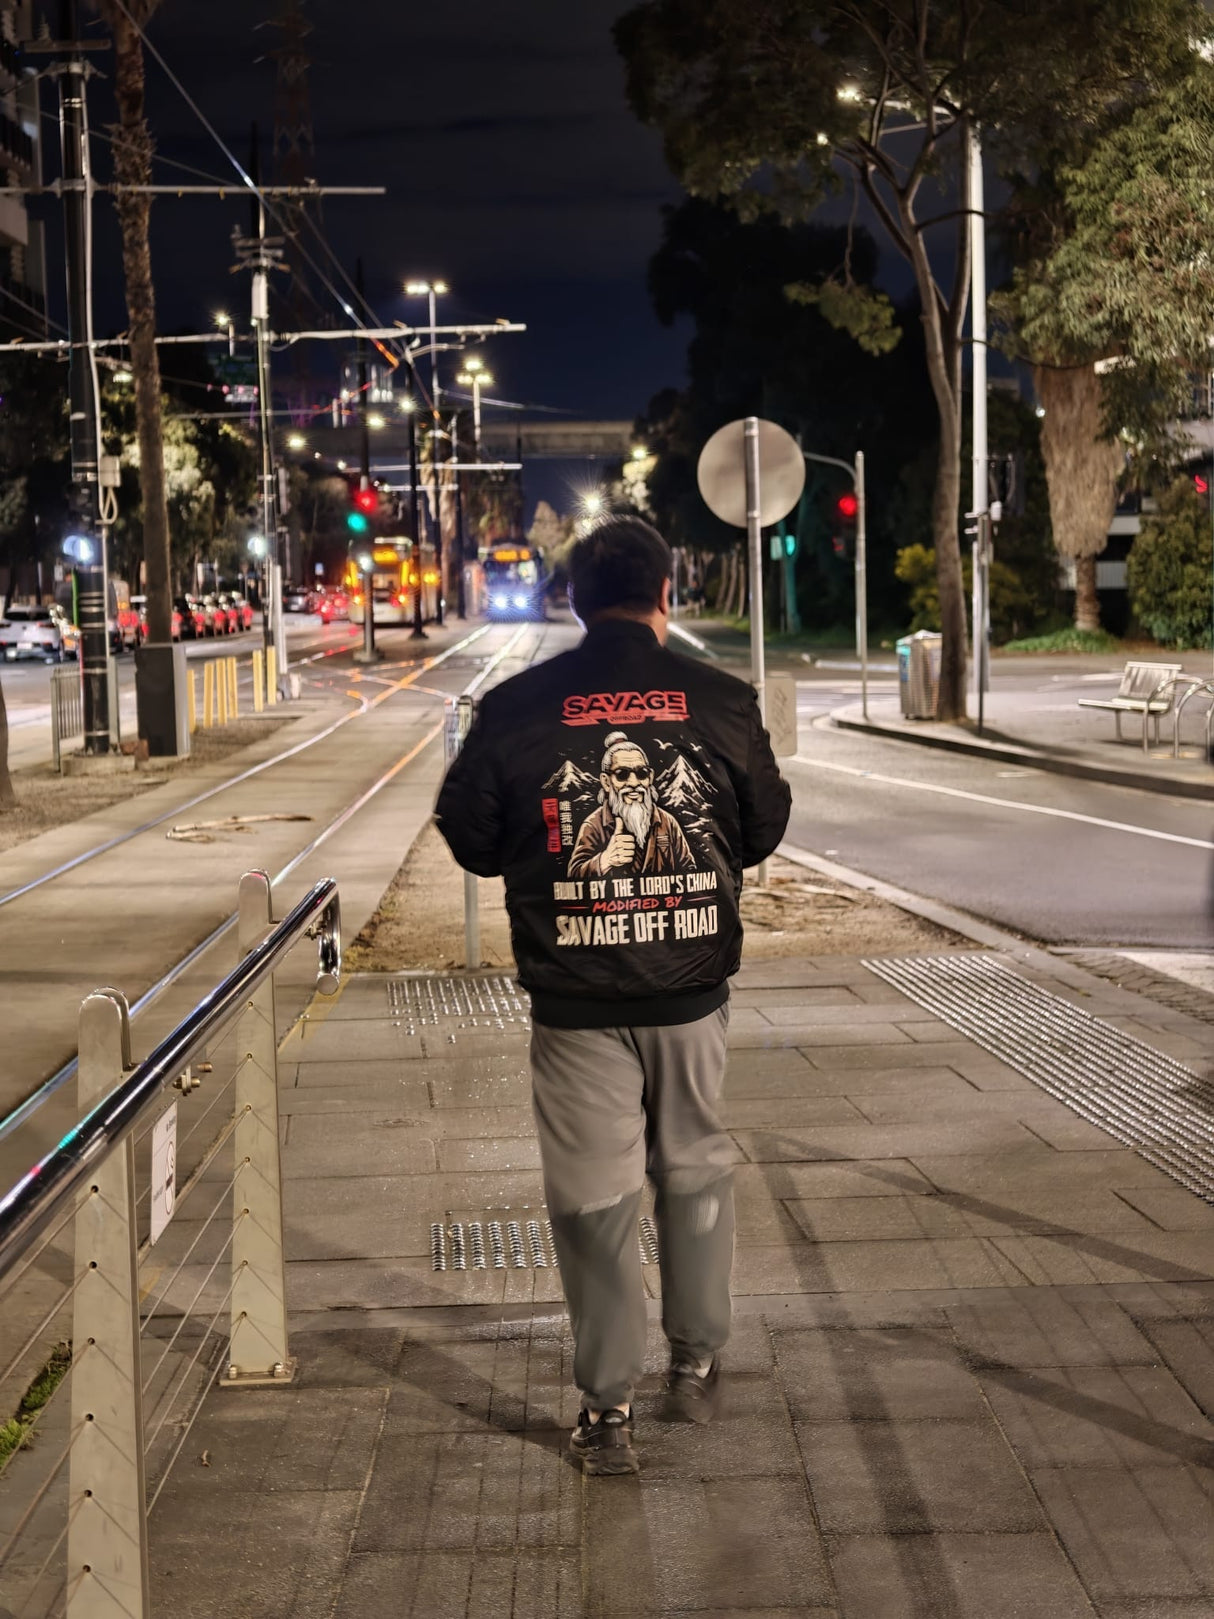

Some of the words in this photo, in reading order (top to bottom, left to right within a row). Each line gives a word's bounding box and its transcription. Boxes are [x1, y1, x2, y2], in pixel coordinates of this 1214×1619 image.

[565, 692, 685, 717] SAVAGE
[553, 881, 583, 900] BUILT
[589, 880, 606, 899] BY
[612, 878, 634, 898] THE
[639, 875, 684, 896] LORD'S
[686, 871, 717, 892] CHINA
[592, 898, 659, 913] MODIFIED
[664, 896, 682, 908] BY
[555, 914, 630, 946] SAVAGE
[633, 911, 669, 943] OFF
[674, 905, 718, 940] ROAD
